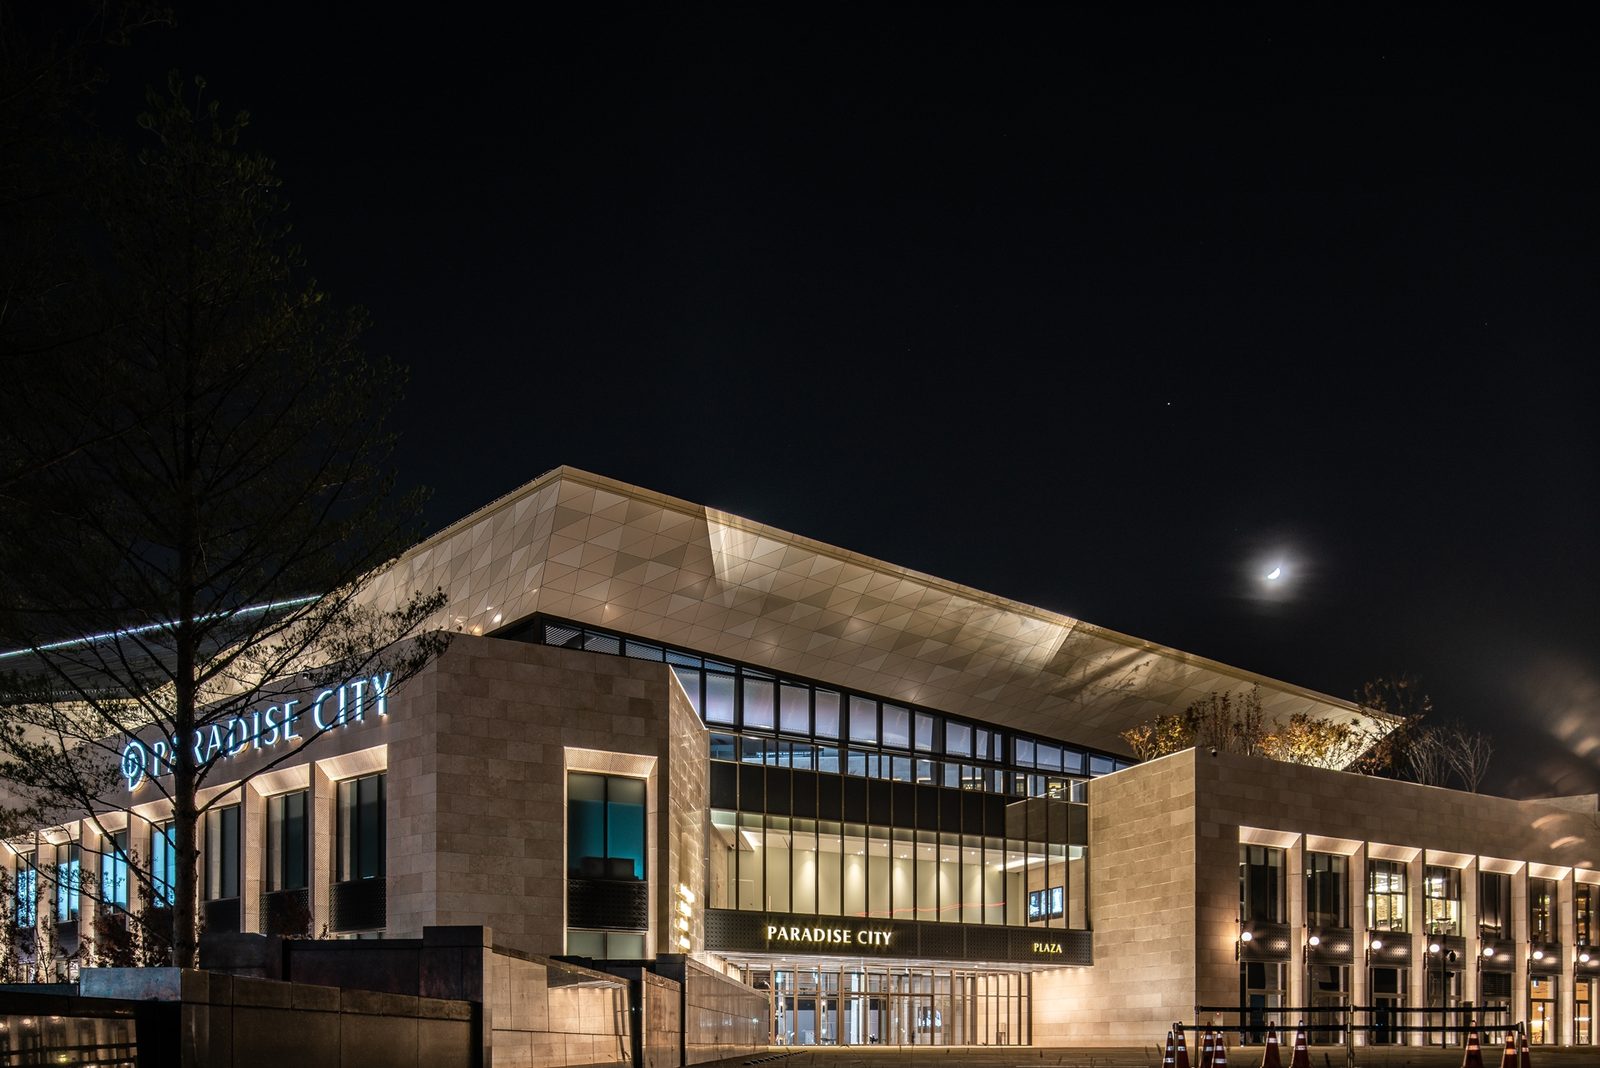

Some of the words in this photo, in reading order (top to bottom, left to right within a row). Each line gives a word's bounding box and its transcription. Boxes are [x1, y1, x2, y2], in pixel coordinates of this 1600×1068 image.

[313, 672, 392, 731] CITY
[767, 925, 852, 944] PARADISE
[857, 930, 892, 945] CITY
[1033, 942, 1063, 954] PLAZA
